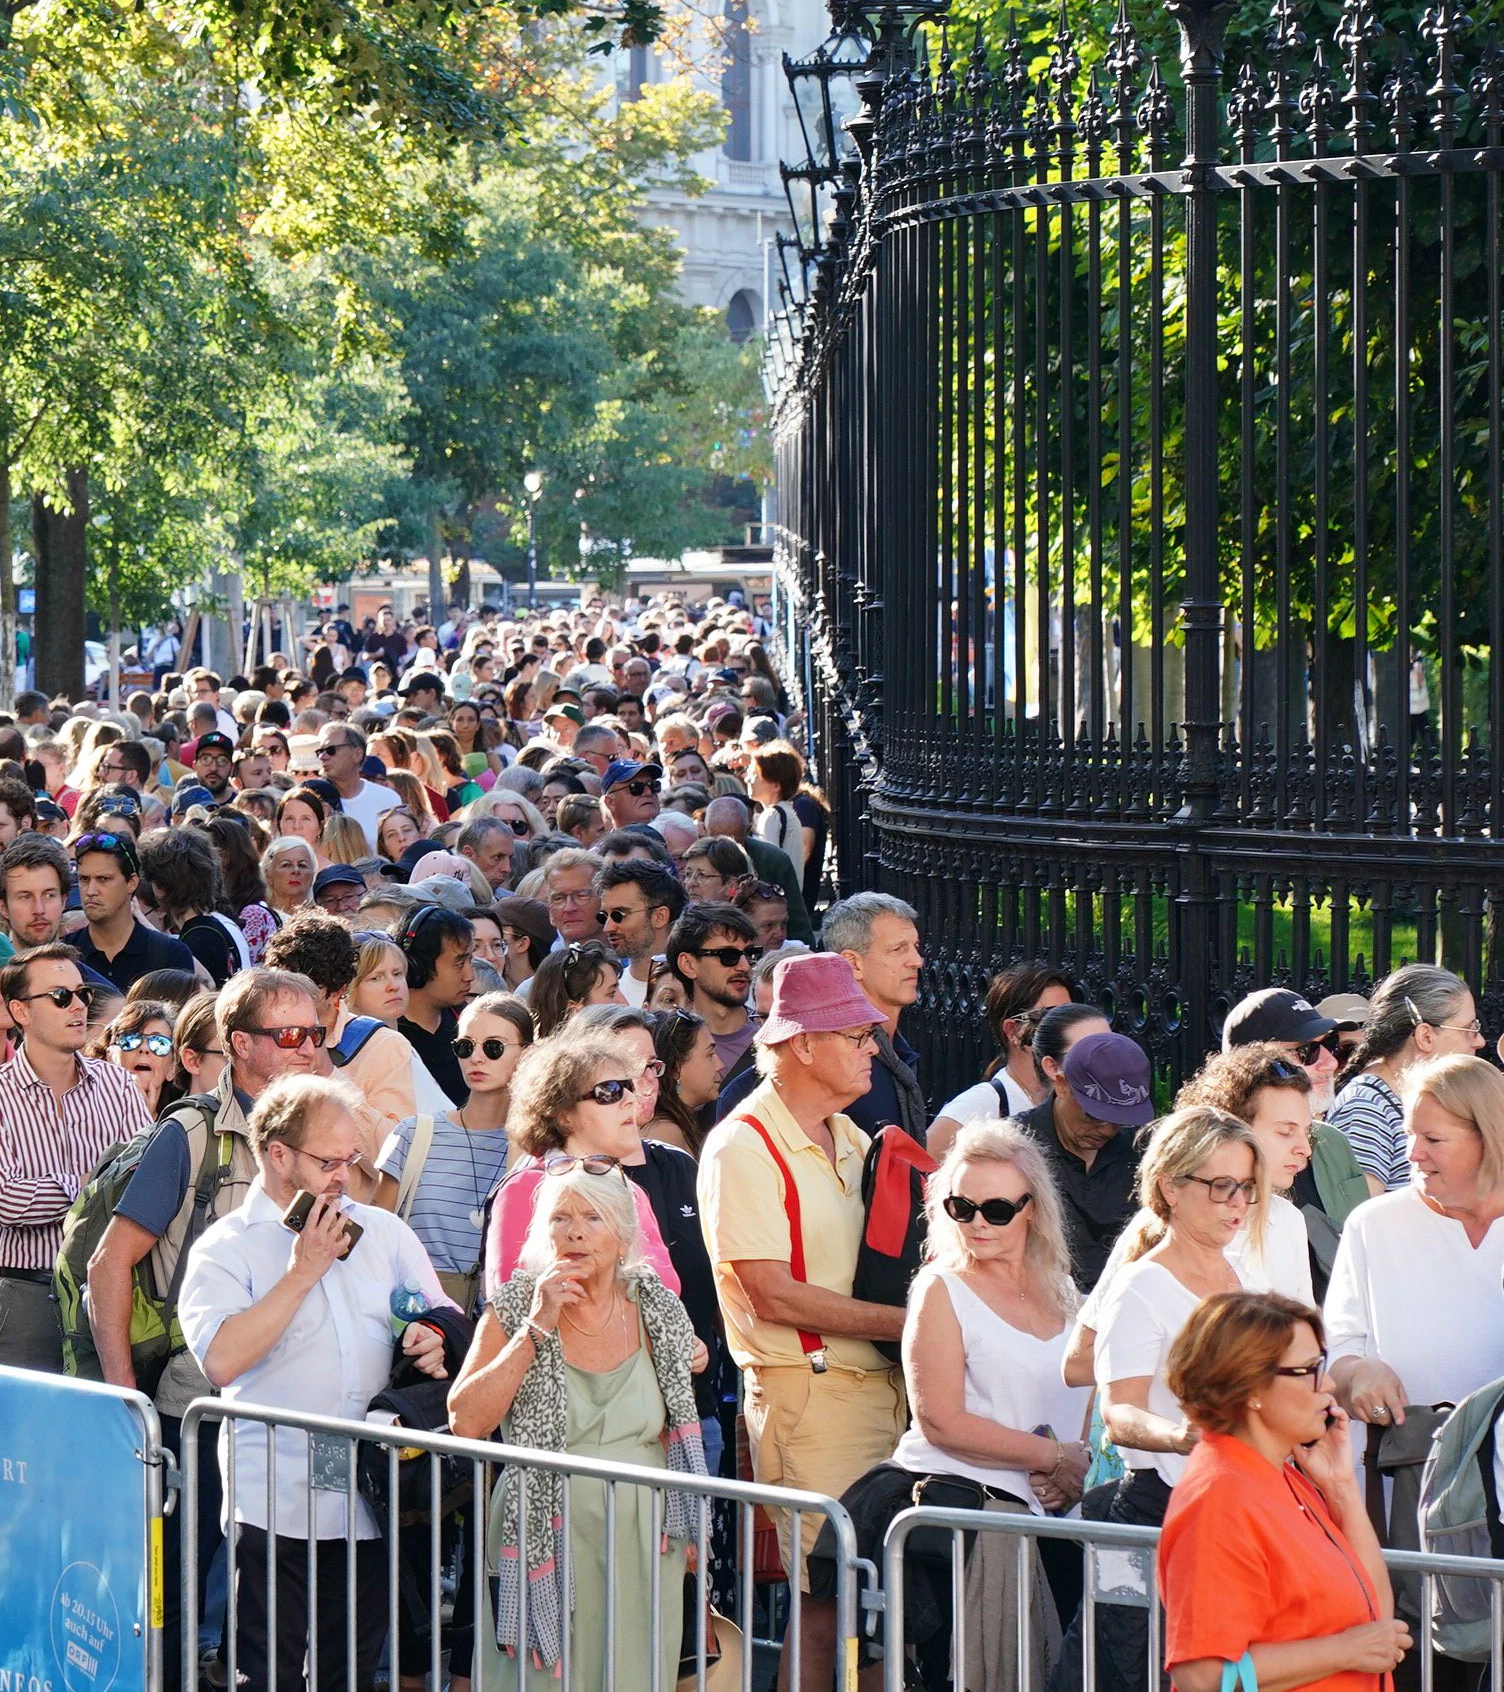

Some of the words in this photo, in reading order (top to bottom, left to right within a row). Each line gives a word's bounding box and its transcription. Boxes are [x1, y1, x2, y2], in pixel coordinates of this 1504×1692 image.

[61, 1592, 71, 1608] ab
[71, 1599, 96, 1627] 20.15
[96, 1616, 114, 1641] Uhr
[64, 1617, 88, 1642] auch
[88, 1634, 105, 1654] auf
